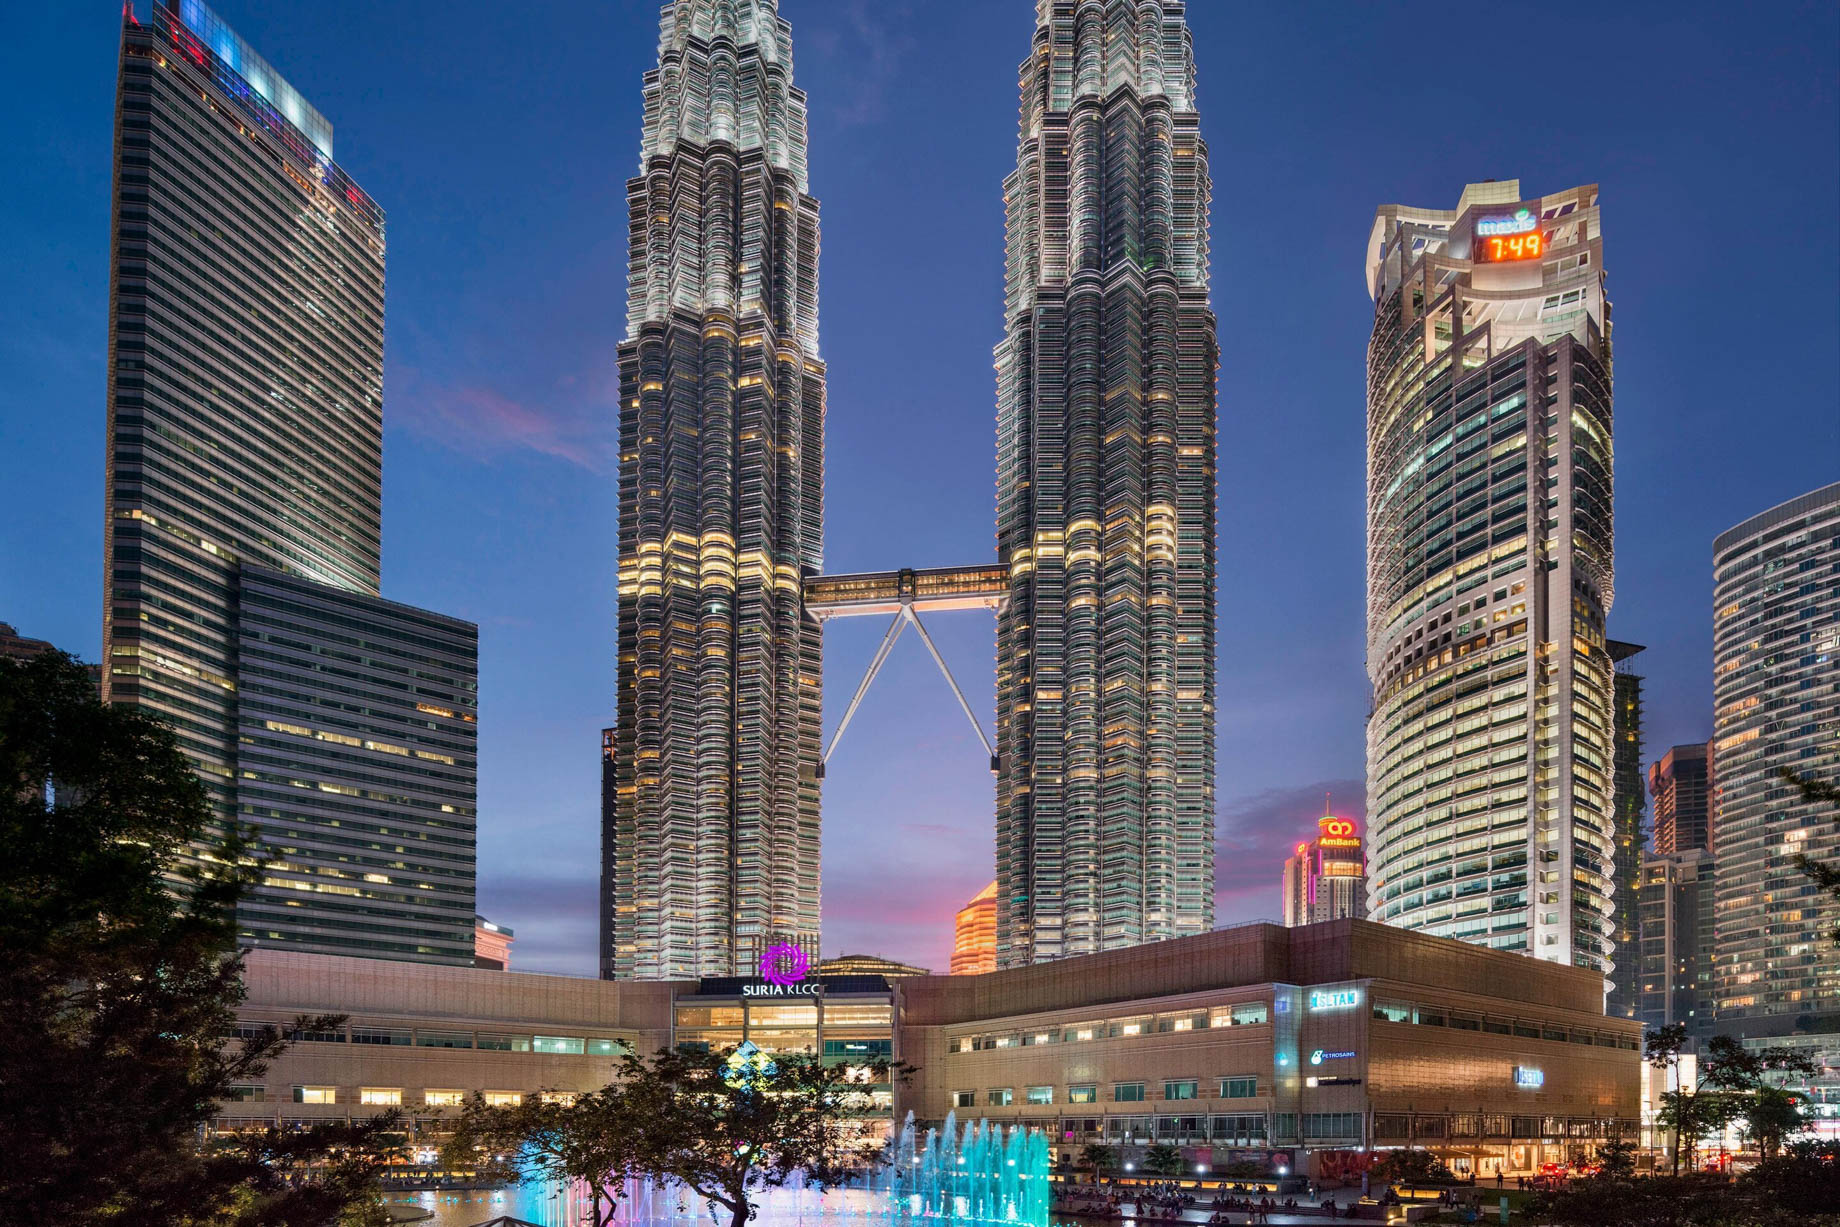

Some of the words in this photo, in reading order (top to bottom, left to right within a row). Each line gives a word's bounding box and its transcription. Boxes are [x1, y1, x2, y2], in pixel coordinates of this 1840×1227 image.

[1477, 211, 1537, 235] maxis
[1491, 235, 1540, 259] 7:49
[1320, 838, 1361, 847] AmBank
[743, 984, 783, 996] SURIA
[787, 984, 820, 995] KLCC
